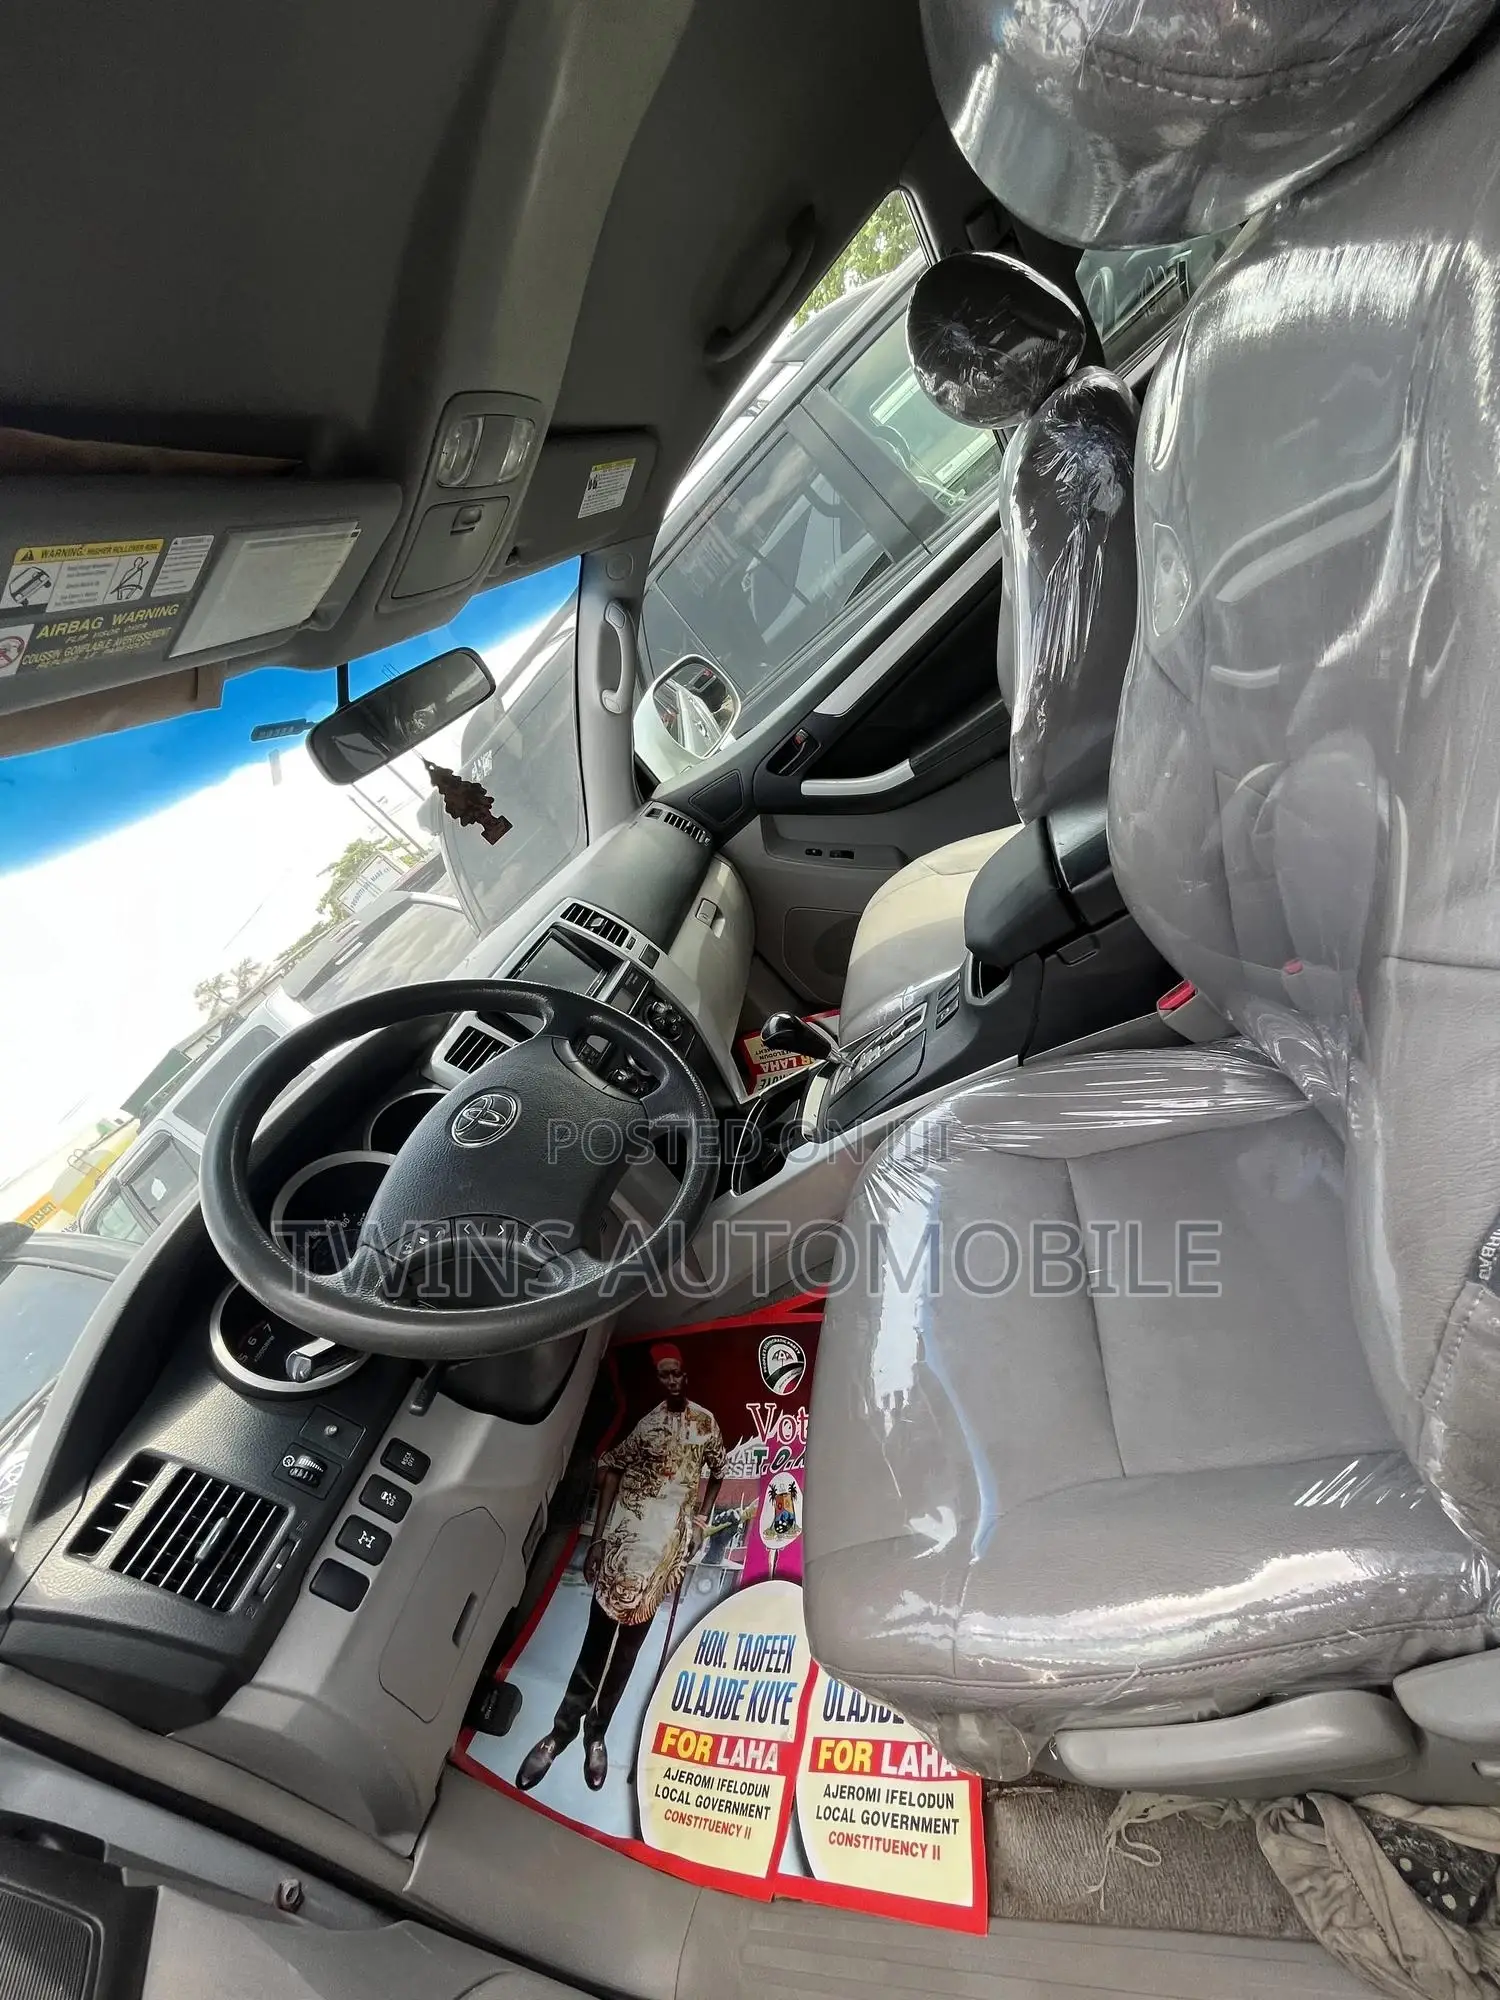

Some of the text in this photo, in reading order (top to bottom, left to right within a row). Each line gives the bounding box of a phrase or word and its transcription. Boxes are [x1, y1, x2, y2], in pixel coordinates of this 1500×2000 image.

[36, 604, 180, 639] AIRBAG WARNING
[760, 1057, 797, 1073] LAHA
[247, 1336, 257, 1346] 6
[263, 1323, 272, 1332] 7
[746, 1403, 809, 1445] Vot
[693, 1629, 797, 1673] HON. TAOFEEK
[671, 1670, 798, 1726] OLAJIDE KUYE
[660, 1726, 778, 1772] FOR LAHA
[818, 1739, 873, 1772] FOR
[663, 1767, 770, 1798] AJEROMI IFELODUN
[823, 1783, 954, 1809] AJEROMI IFELODUN
[654, 1784, 771, 1820] LOCAL GOVERNMENT
[664, 1808, 752, 1840] CONSTITUENCY II
[816, 1805, 960, 1835] LOCAL GOVERNMENT
[828, 1831, 941, 1860] CONSTITUENCY II
